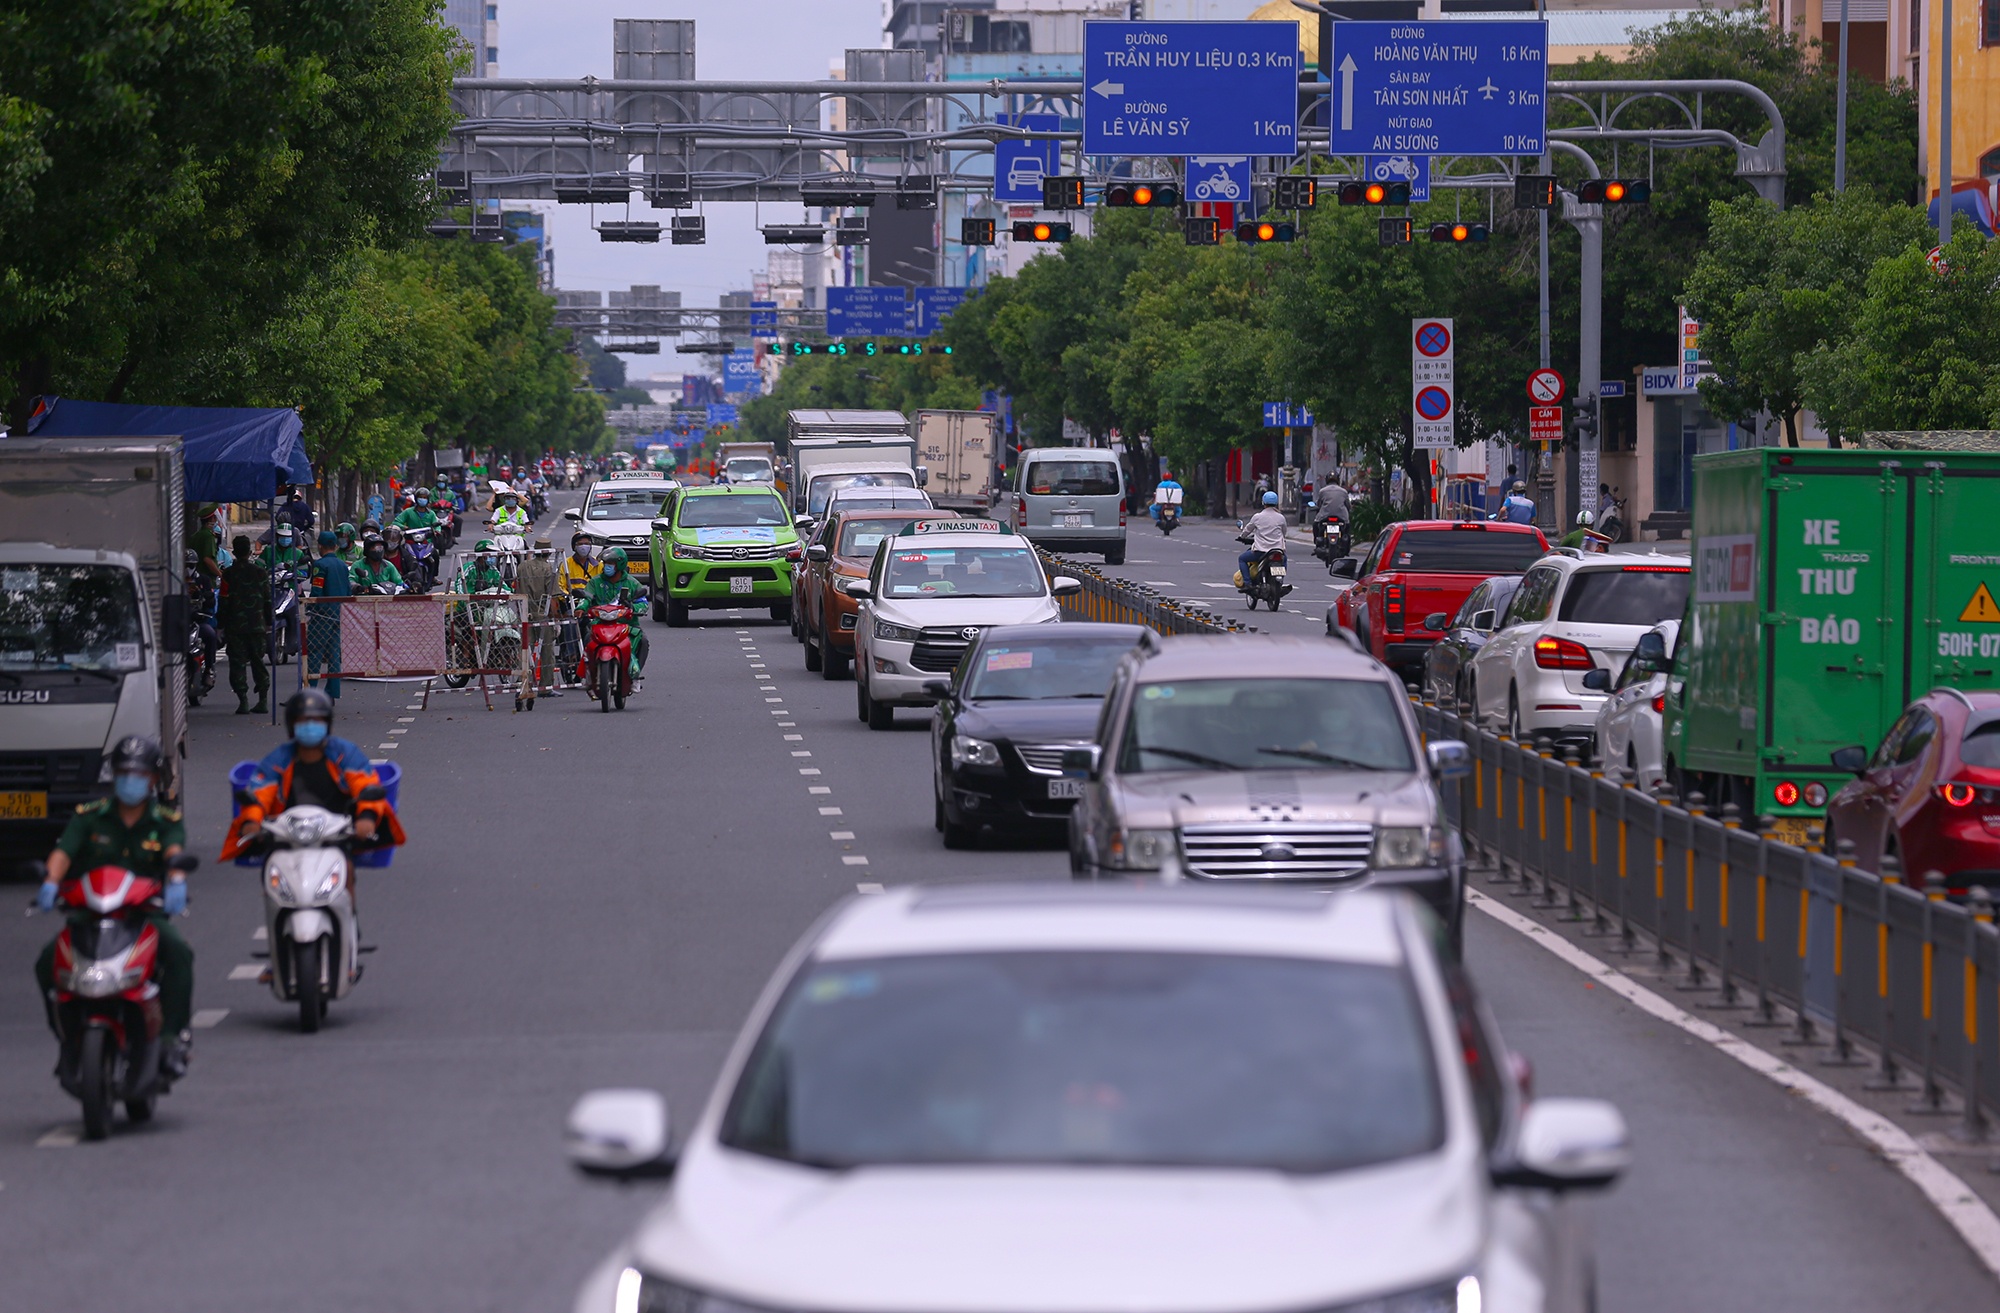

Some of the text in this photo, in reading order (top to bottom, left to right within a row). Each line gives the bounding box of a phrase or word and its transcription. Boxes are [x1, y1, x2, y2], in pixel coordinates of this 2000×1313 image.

[1125, 31, 1168, 45] ĐƯỜNG
[1391, 26, 1425, 39] ĐƯỜNG
[1104, 46, 1293, 70] TRẦN HUY LIỆU 0,3 Km
[1374, 42, 1419, 61] HOÀNG
[1423, 43, 1449, 61] VĂN
[1452, 46, 1478, 64] THỤ
[1520, 46, 1541, 61] Km
[1389, 70, 1430, 84] SÂN BAY
[1374, 84, 1539, 106] TÂN SƠN NHẤT 3 Km
[1125, 100, 1168, 114] ĐƯỜNG
[1103, 117, 1292, 136] LÊ VĂN SỸ 1 Km
[1388, 115, 1433, 129] NÚT GIAO
[1373, 134, 1539, 150] AN SƯƠNG 10 Km
[1600, 385, 1617, 393] ATM
[1644, 374, 1677, 389] BIDV
[1539, 408, 1552, 418] CẤM
[1803, 519, 1840, 546] XE
[1822, 553, 1870, 563] THACO
[1797, 567, 1858, 596] THƯ
[1800, 613, 1861, 645] BÁO
